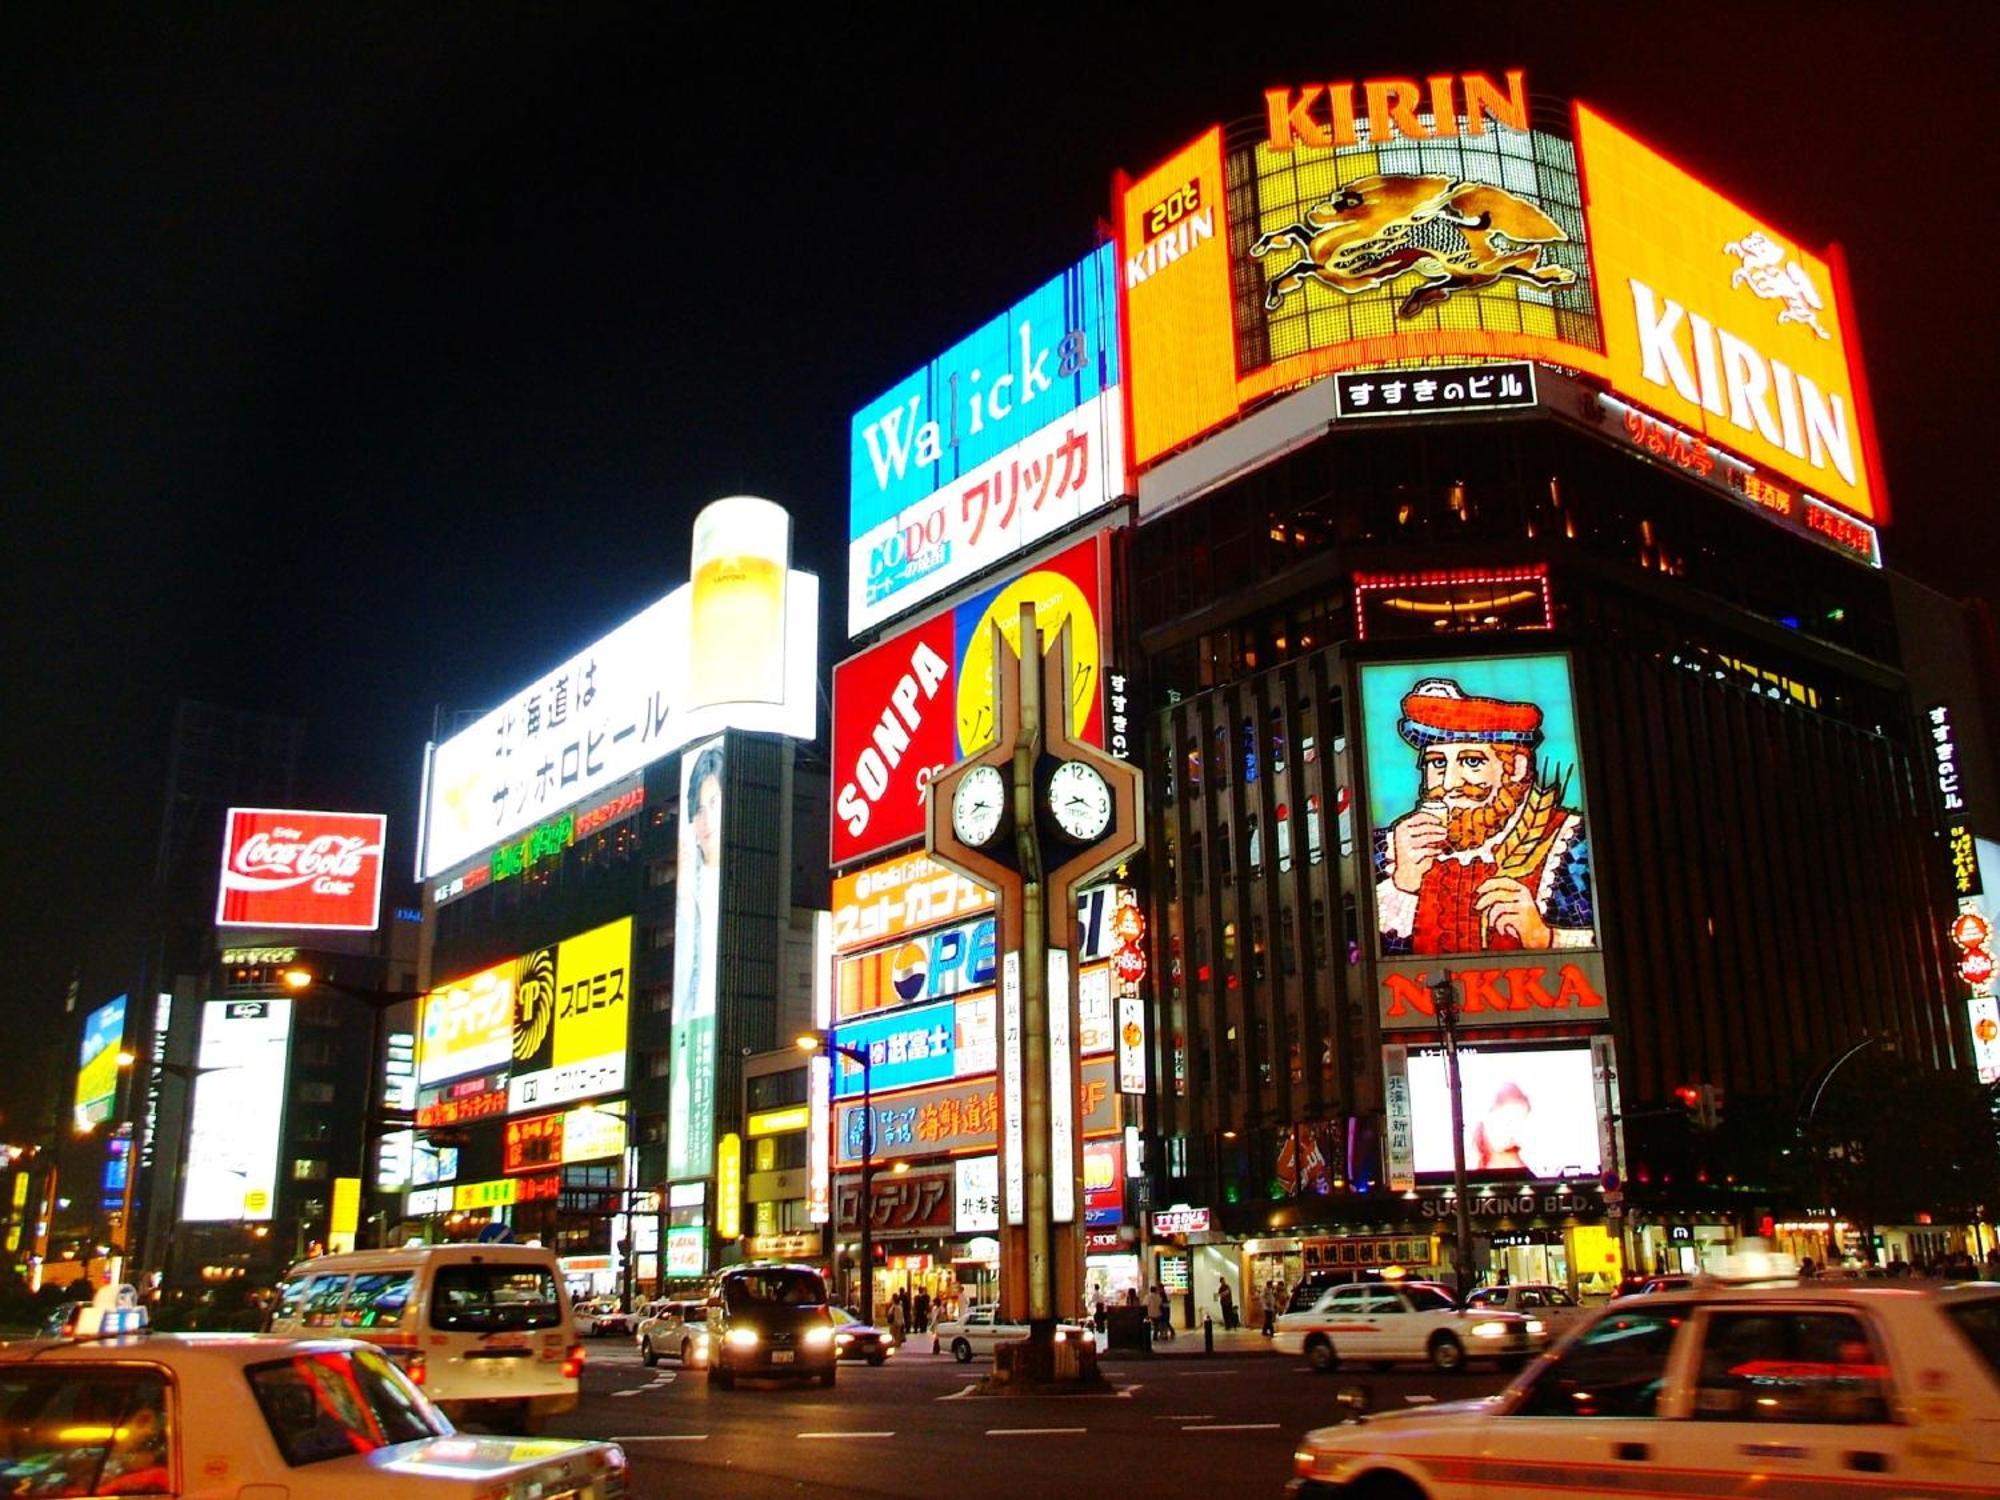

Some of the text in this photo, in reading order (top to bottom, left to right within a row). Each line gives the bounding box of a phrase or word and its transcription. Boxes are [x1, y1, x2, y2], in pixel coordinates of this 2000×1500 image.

[1265, 71, 1531, 151] KIRIN
[1127, 207, 1213, 288] KIRIN
[862, 320, 1088, 491] Walicka
[1348, 373, 1524, 406] すすきのビル
[1630, 279, 1857, 487] KIRIN
[961, 428, 1089, 545] ワリッカ
[495, 658, 597, 757] 北海道は
[837, 641, 948, 837] SONPA
[1071, 764, 1084, 780] 12
[1928, 706, 1963, 810] すすきのビル
[1074, 822, 1084, 837] 6
[1098, 797, 1108, 814] 3
[236, 832, 366, 876] Coca-Cola
[560, 967, 625, 1019] プロミス
[1382, 963, 1604, 1018] NKKA
